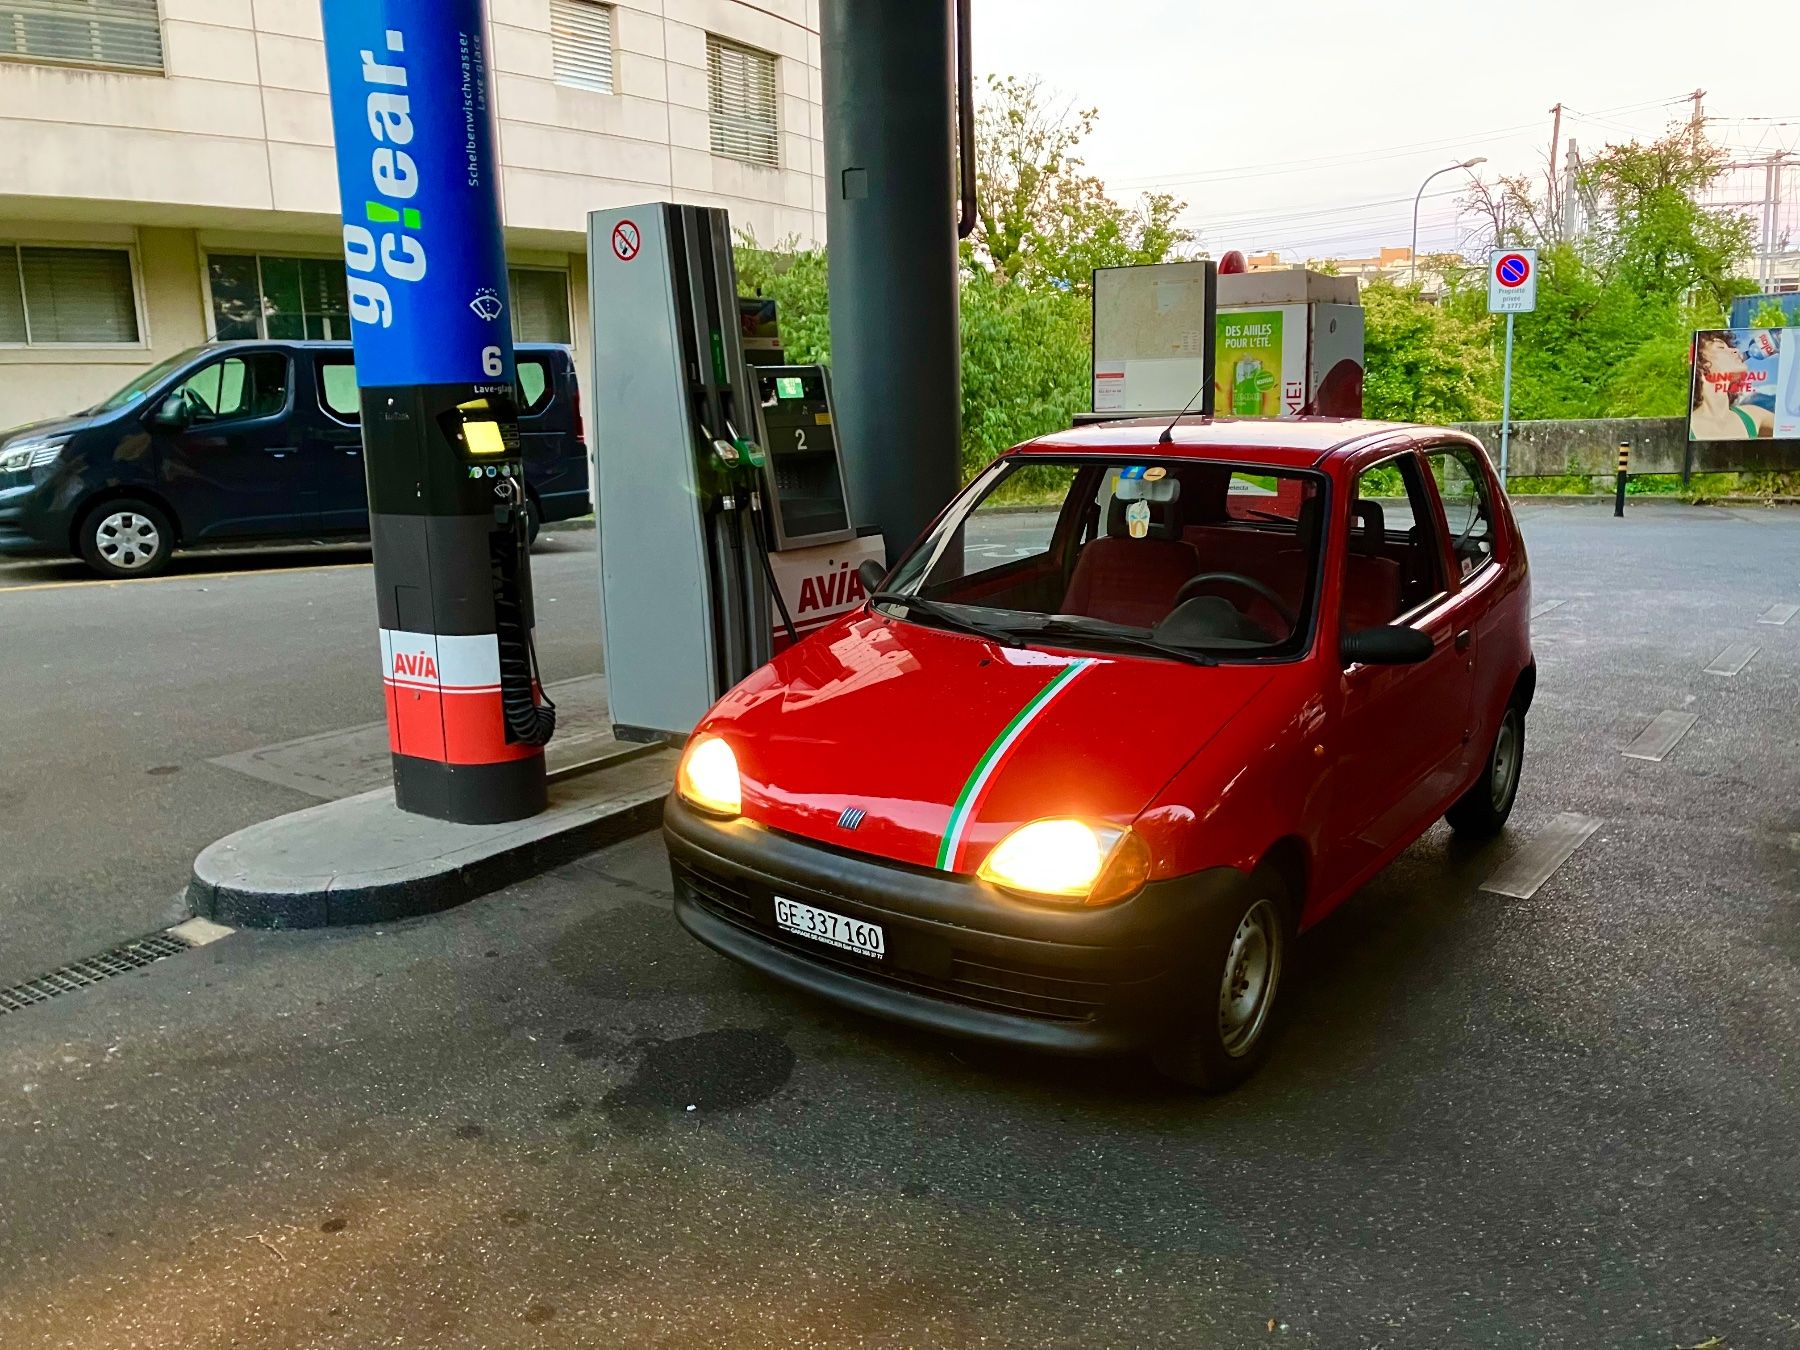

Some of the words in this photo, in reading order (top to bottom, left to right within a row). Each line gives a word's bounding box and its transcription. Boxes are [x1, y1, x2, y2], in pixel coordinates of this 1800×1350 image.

[343, 224, 392, 329] go
[1225, 325, 1241, 337] DES
[1225, 338, 1248, 348] POUR
[481, 345, 503, 377] 6
[795, 429, 808, 450] 2
[797, 562, 867, 614] AVIA
[394, 651, 438, 679] AVIA
